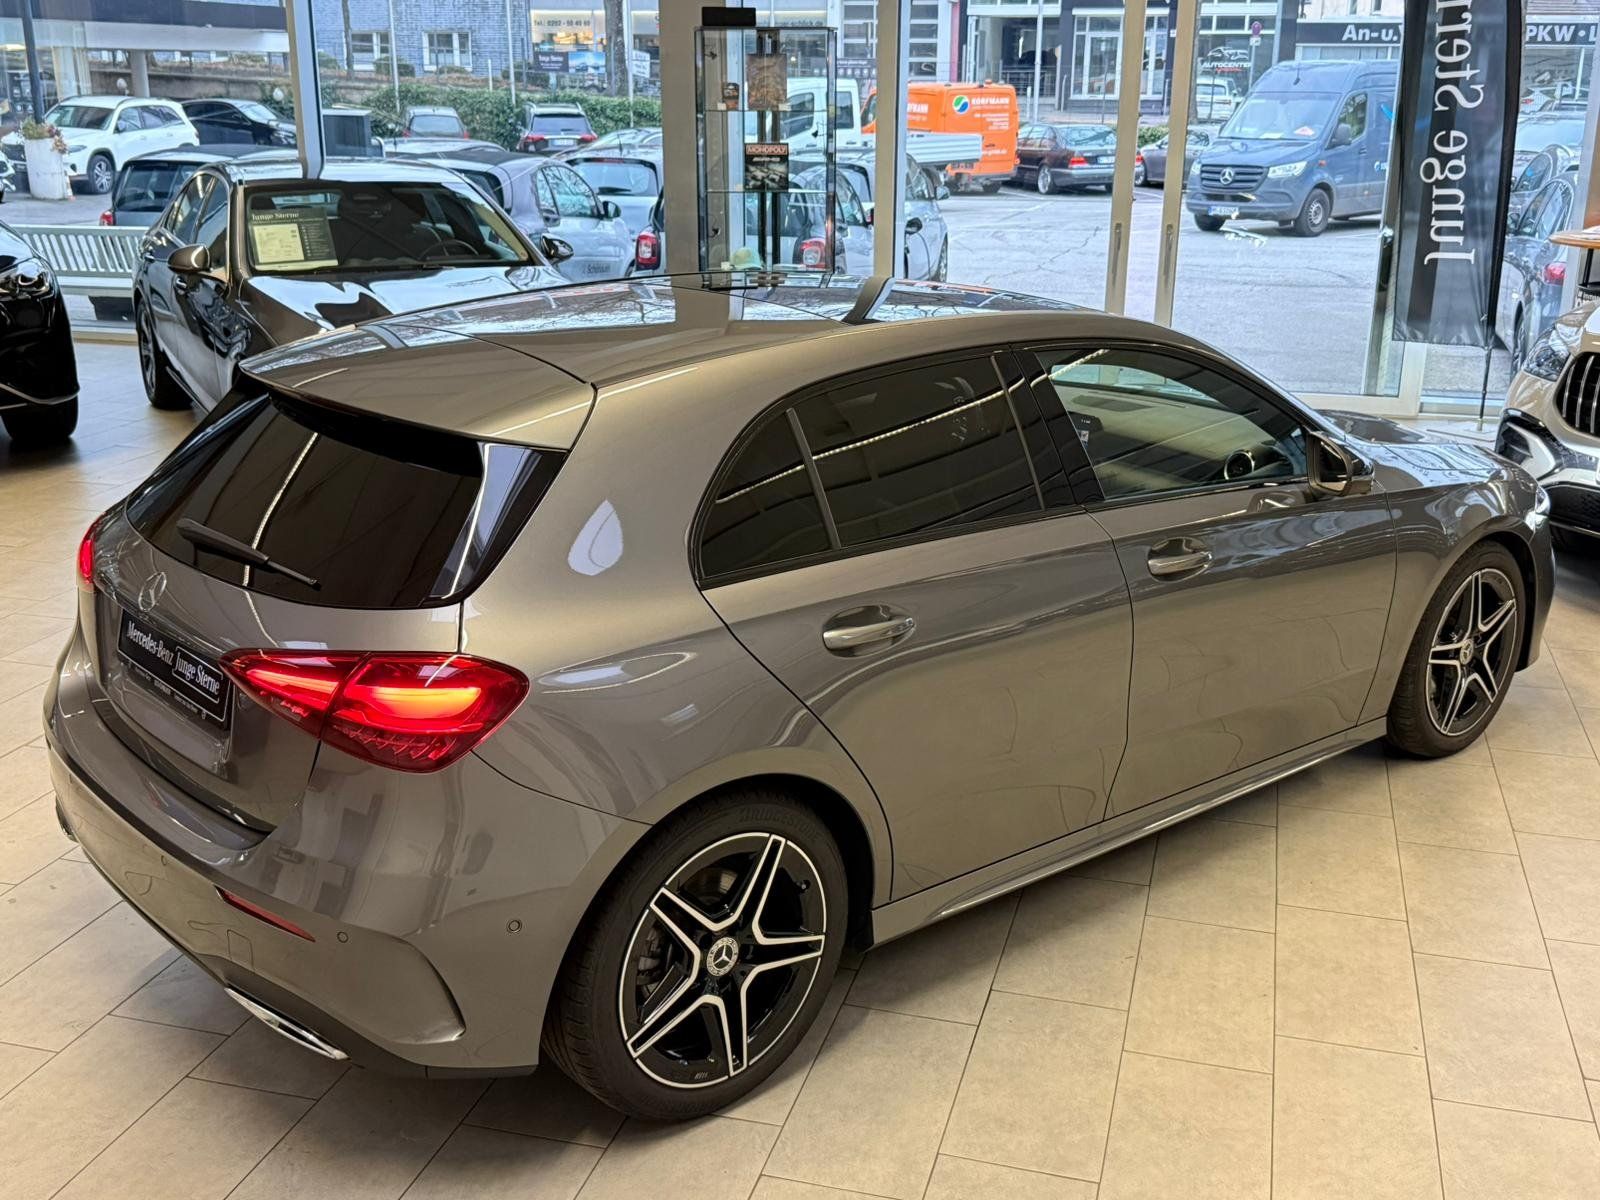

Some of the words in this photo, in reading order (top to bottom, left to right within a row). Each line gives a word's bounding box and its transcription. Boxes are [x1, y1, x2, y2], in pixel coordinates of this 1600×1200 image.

[1525, 25, 1575, 42] PKW
[747, 145, 786, 154] MONOPOLY
[126, 621, 174, 665] Mercedes-Benz
[174, 652, 195, 680] Junge
[195, 665, 220, 695] Sterne
